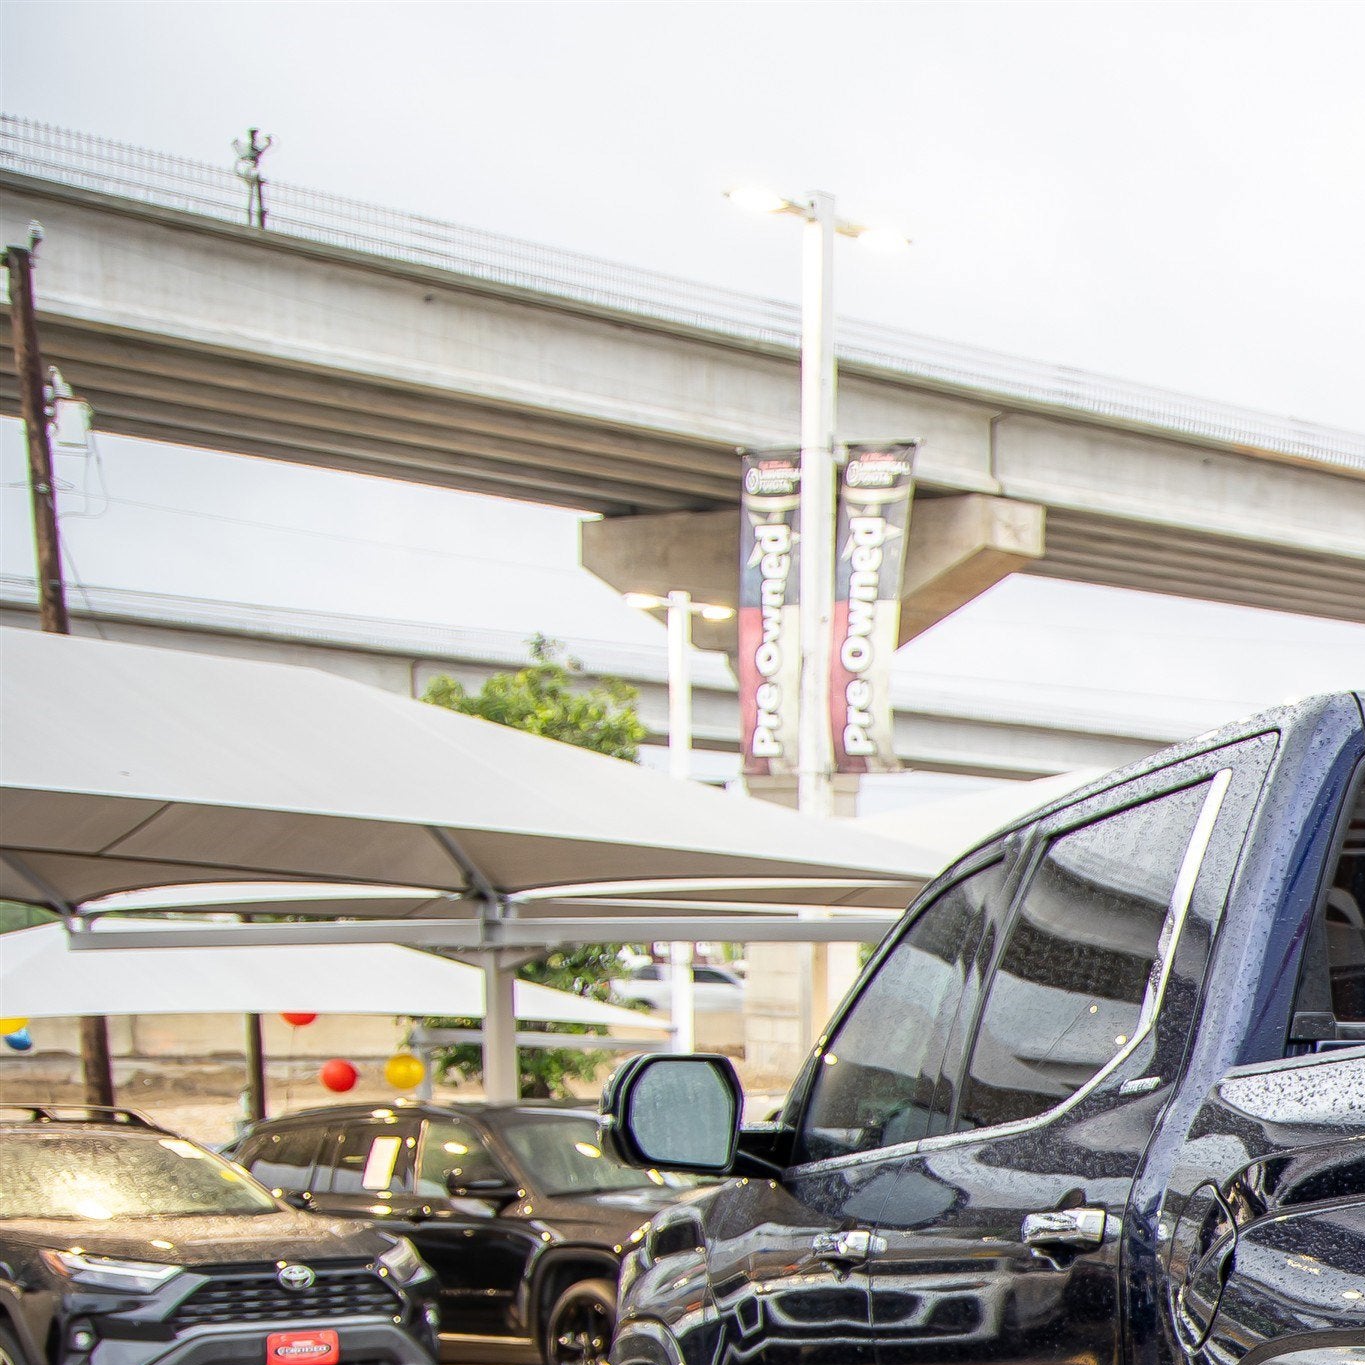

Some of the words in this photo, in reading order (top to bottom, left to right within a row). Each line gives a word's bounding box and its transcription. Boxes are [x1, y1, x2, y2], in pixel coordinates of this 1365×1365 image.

[754, 525, 792, 678] Owned
[841, 516, 887, 674] Owned
[752, 681, 784, 758] Pre
[843, 678, 878, 756] Pre
